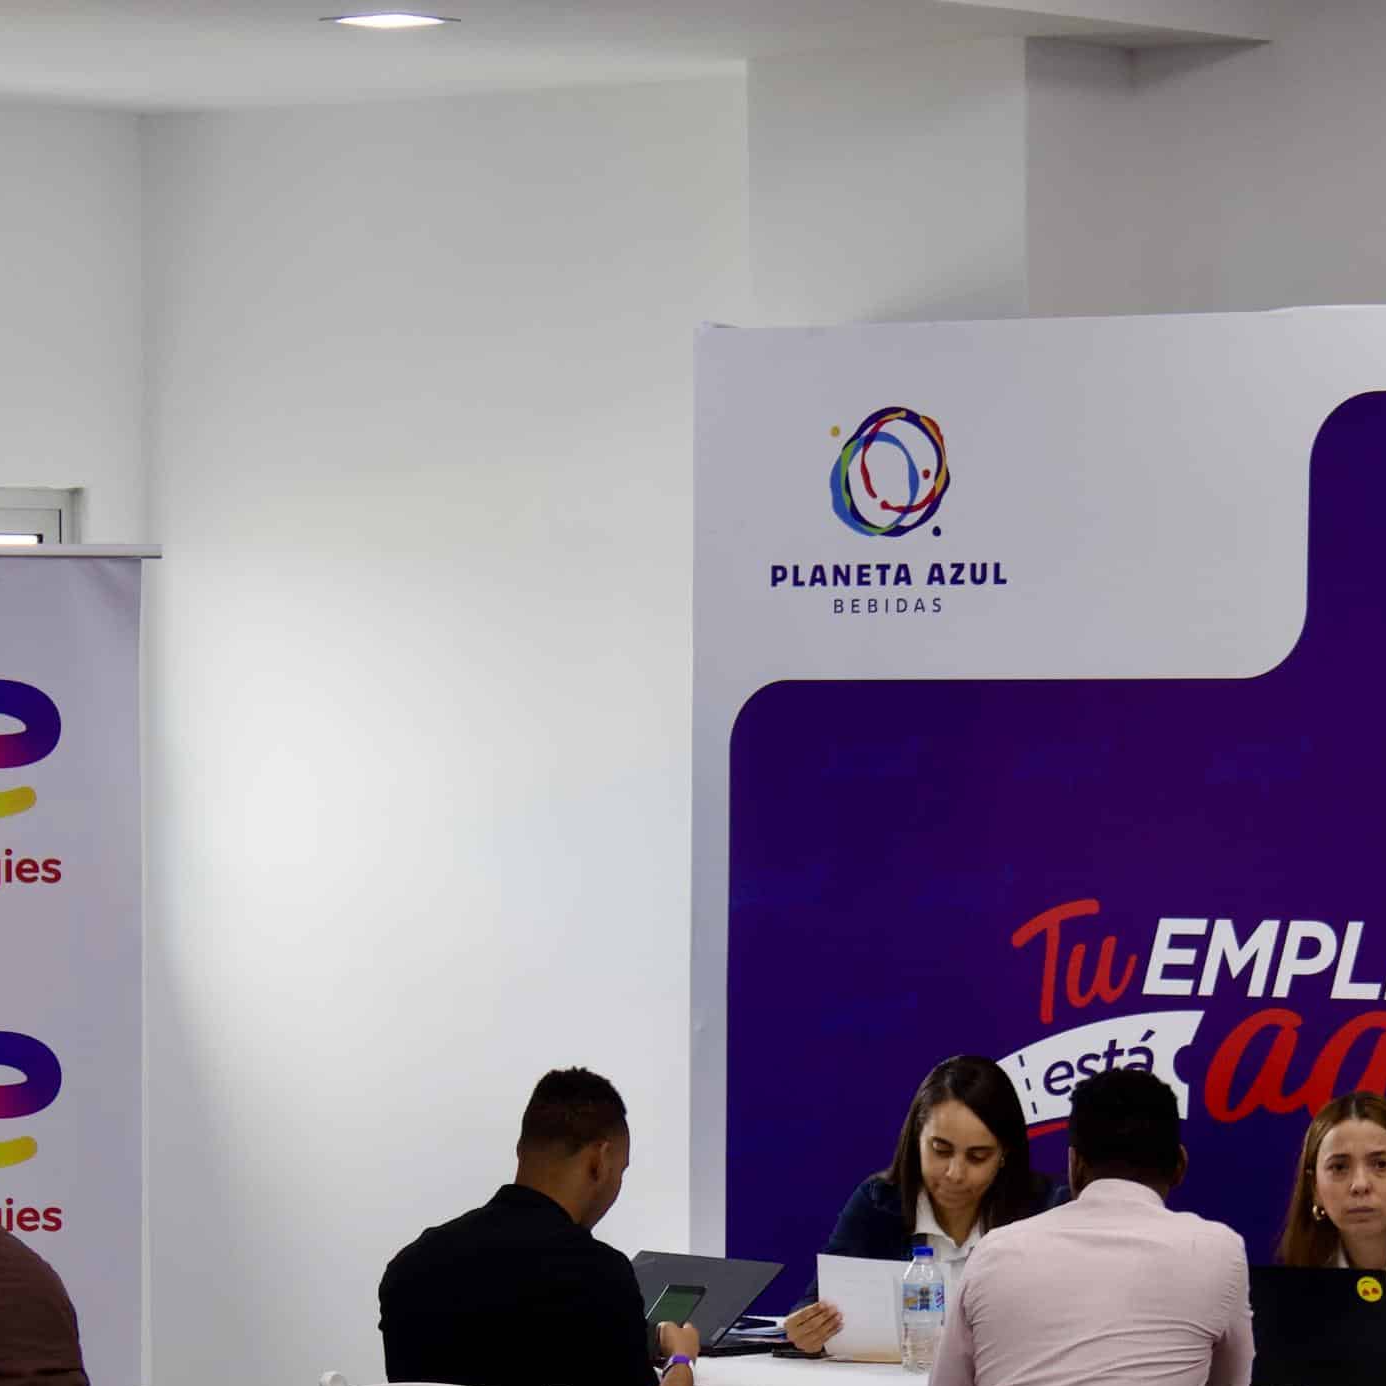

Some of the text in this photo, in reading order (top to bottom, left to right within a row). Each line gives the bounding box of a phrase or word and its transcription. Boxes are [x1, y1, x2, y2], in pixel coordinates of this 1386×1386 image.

[770, 562, 1008, 588] PLANETA AZUL
[833, 598, 943, 614] BEBIDAS
[1011, 898, 1138, 1024] Tu
